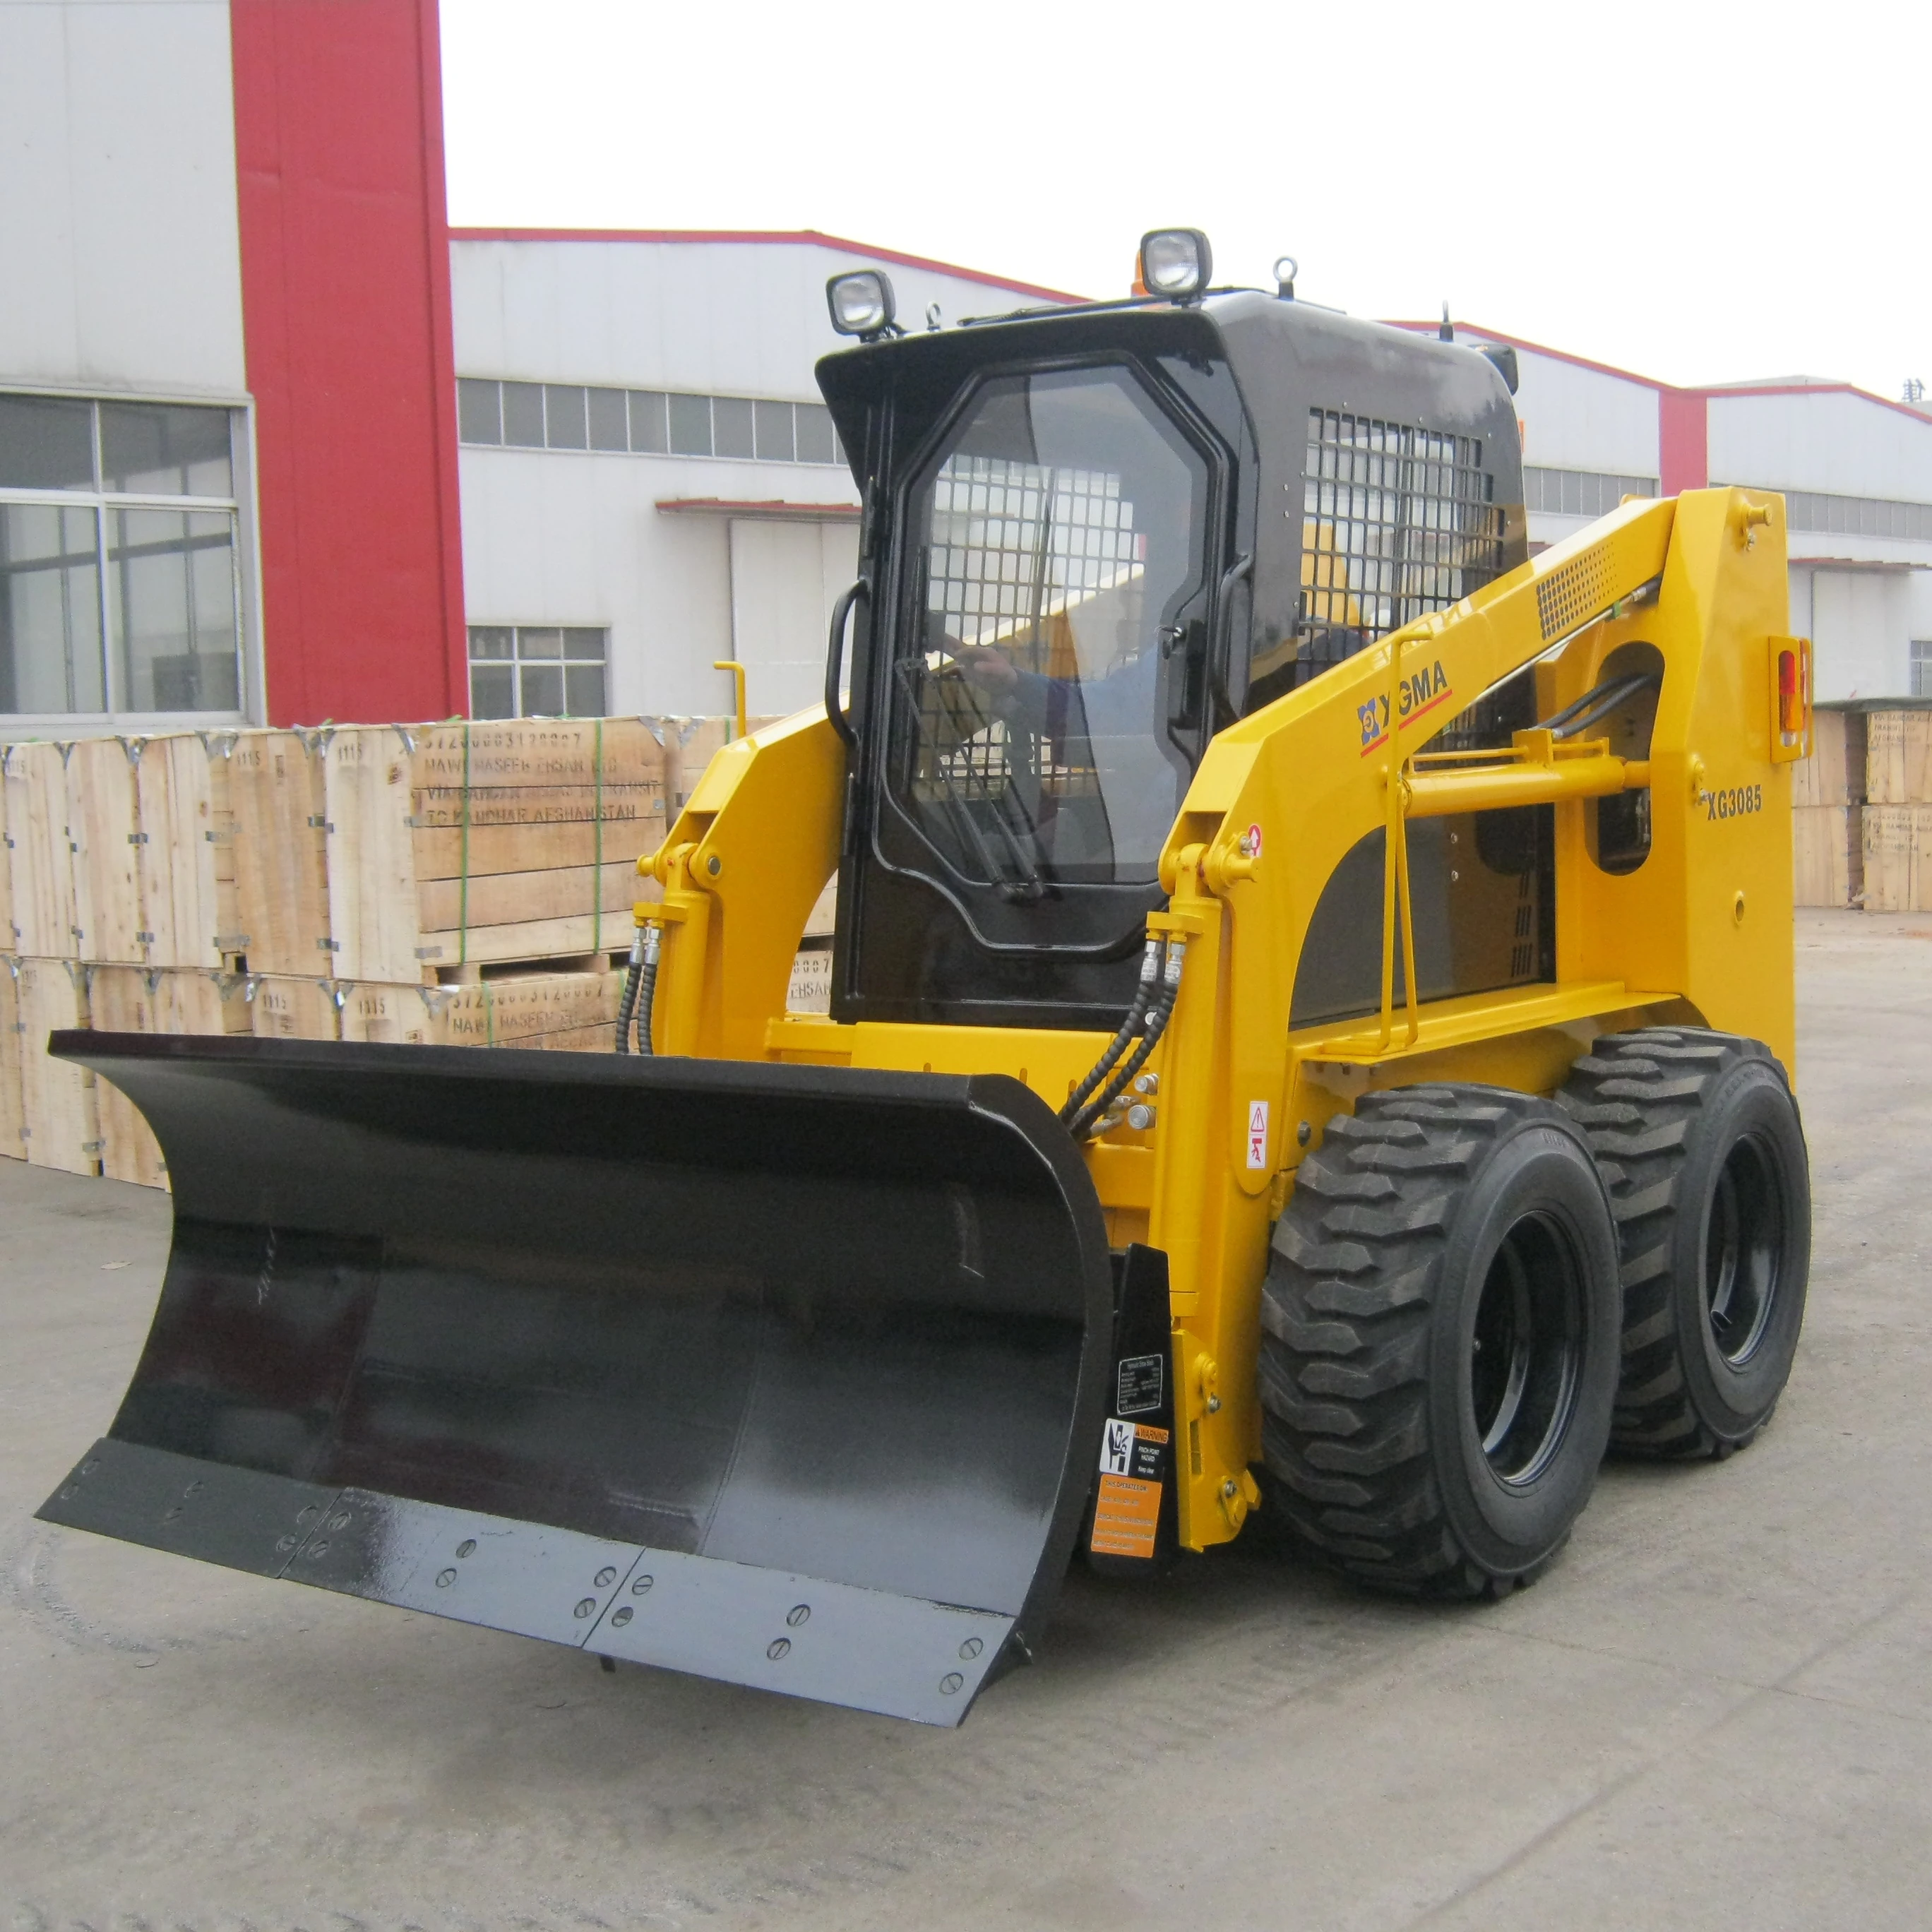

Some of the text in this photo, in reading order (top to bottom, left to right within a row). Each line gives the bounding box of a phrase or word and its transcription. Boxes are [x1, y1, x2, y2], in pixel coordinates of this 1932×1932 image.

[237, 750, 261, 766] 1115
[339, 744, 363, 761] 1115
[1707, 785, 1761, 821] XG3085
[533, 804, 636, 822] AFGHANSTAN
[359, 997, 385, 1015] 1115
[1139, 1427, 1168, 1443] WARNING
